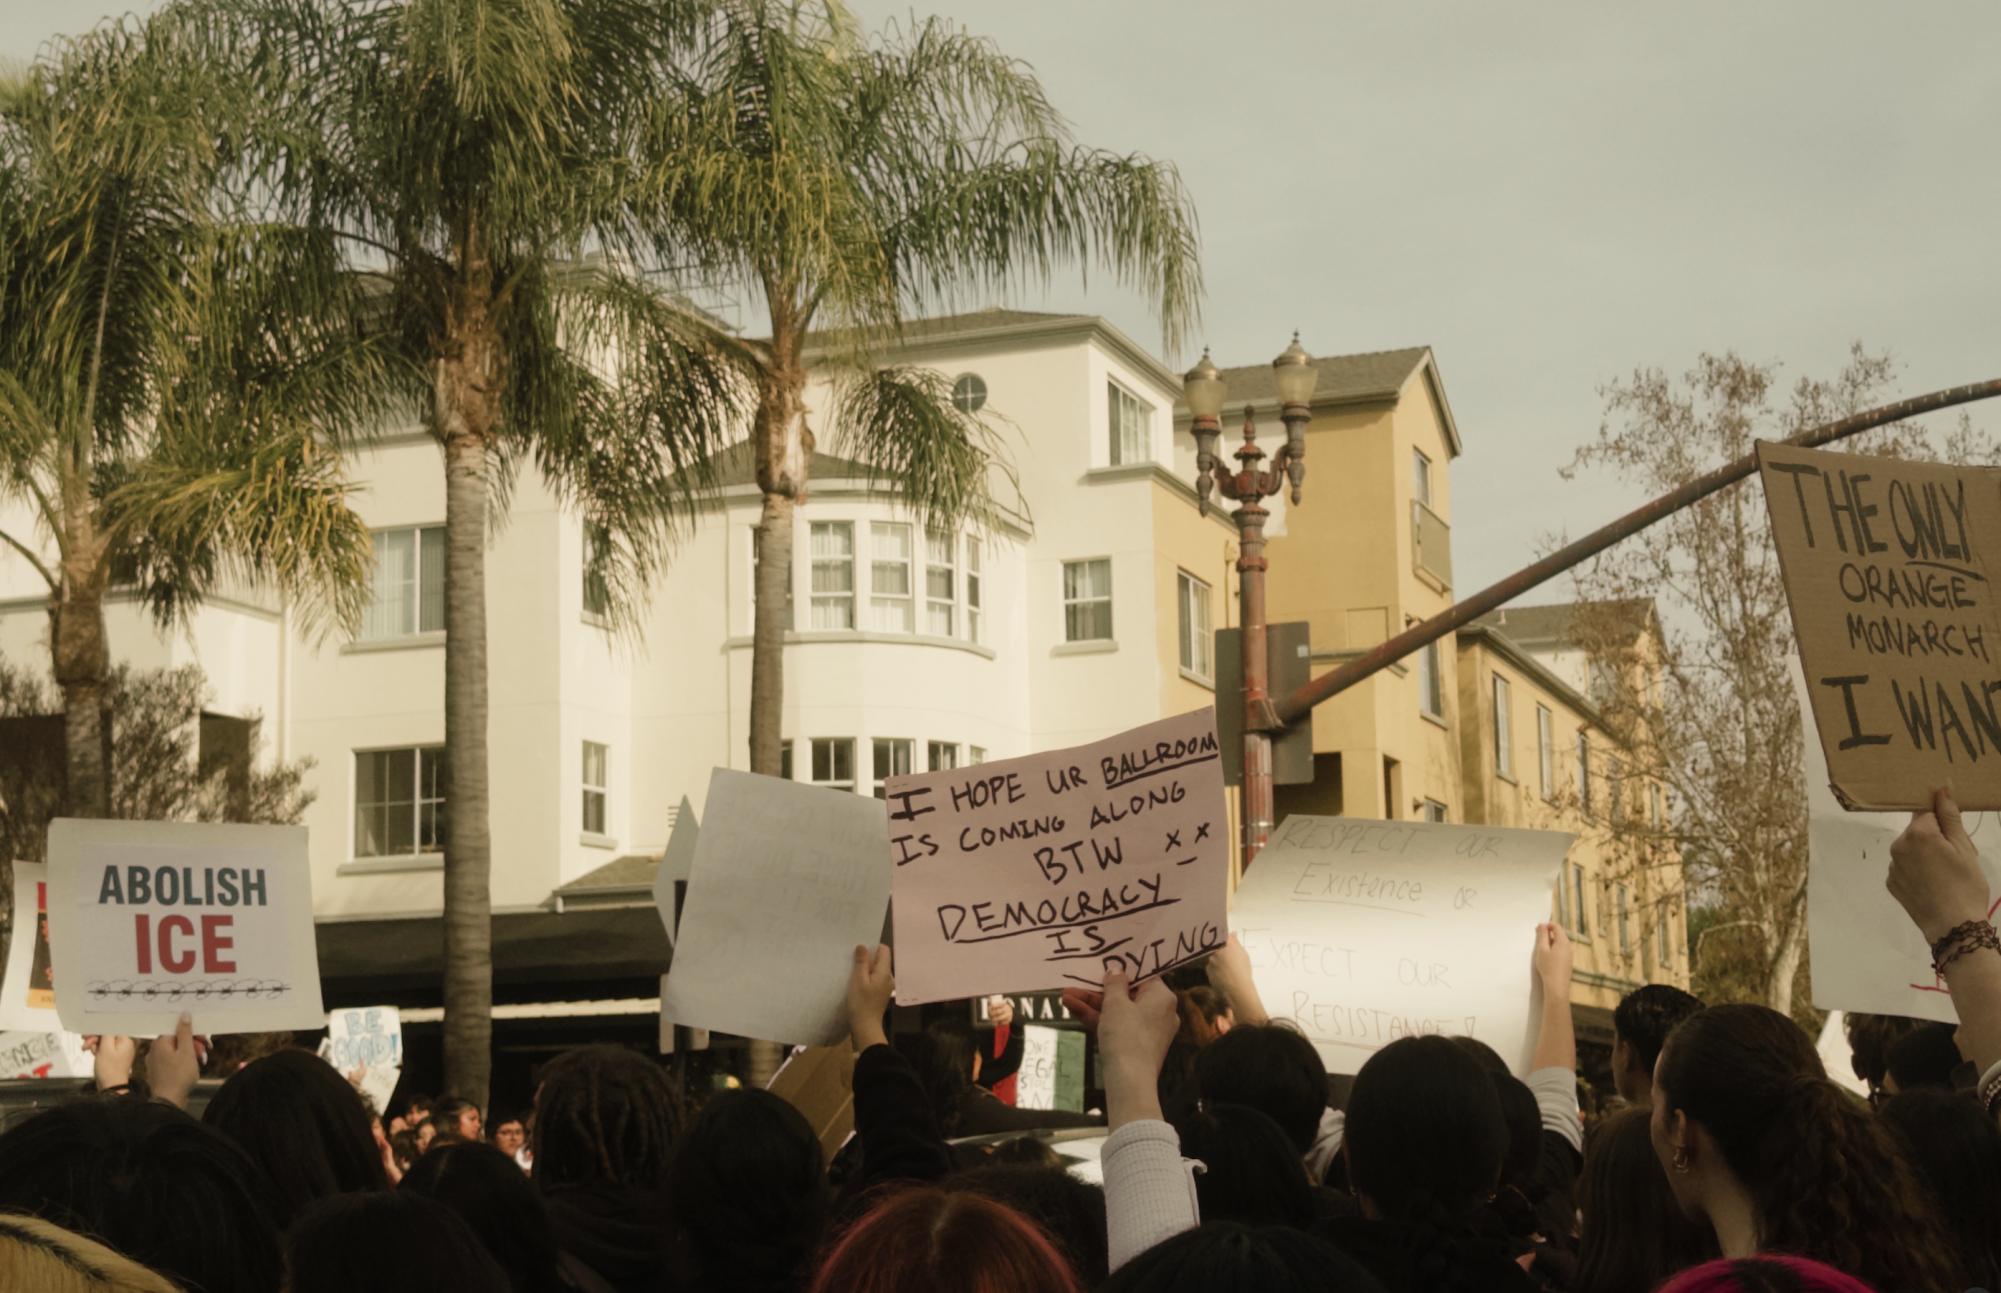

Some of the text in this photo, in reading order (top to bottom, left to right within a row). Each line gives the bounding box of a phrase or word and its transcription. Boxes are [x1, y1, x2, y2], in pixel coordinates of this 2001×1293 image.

[1767, 461, 1972, 564] THE ONLY
[1839, 562, 1976, 612] ORANGE
[1847, 612, 1990, 664] MONARCH
[1820, 674, 1893, 751] I
[888, 731, 1218, 821] I HOPE UR BALLROOM
[891, 781, 1186, 866] IS COMING ALONG
[1277, 819, 1503, 858] RESPECT OUR
[99, 865, 267, 906] ABOLISH
[1034, 837, 1123, 885] BTW
[937, 873, 1161, 940] DEMOCRACY
[1453, 886, 1477, 910] OR
[135, 914, 237, 974] ICE
[1046, 925, 1106, 954] IS
[1102, 921, 1217, 981] DYING
[1242, 928, 1451, 989] EXPECT OUR
[344, 1010, 384, 1036] BE
